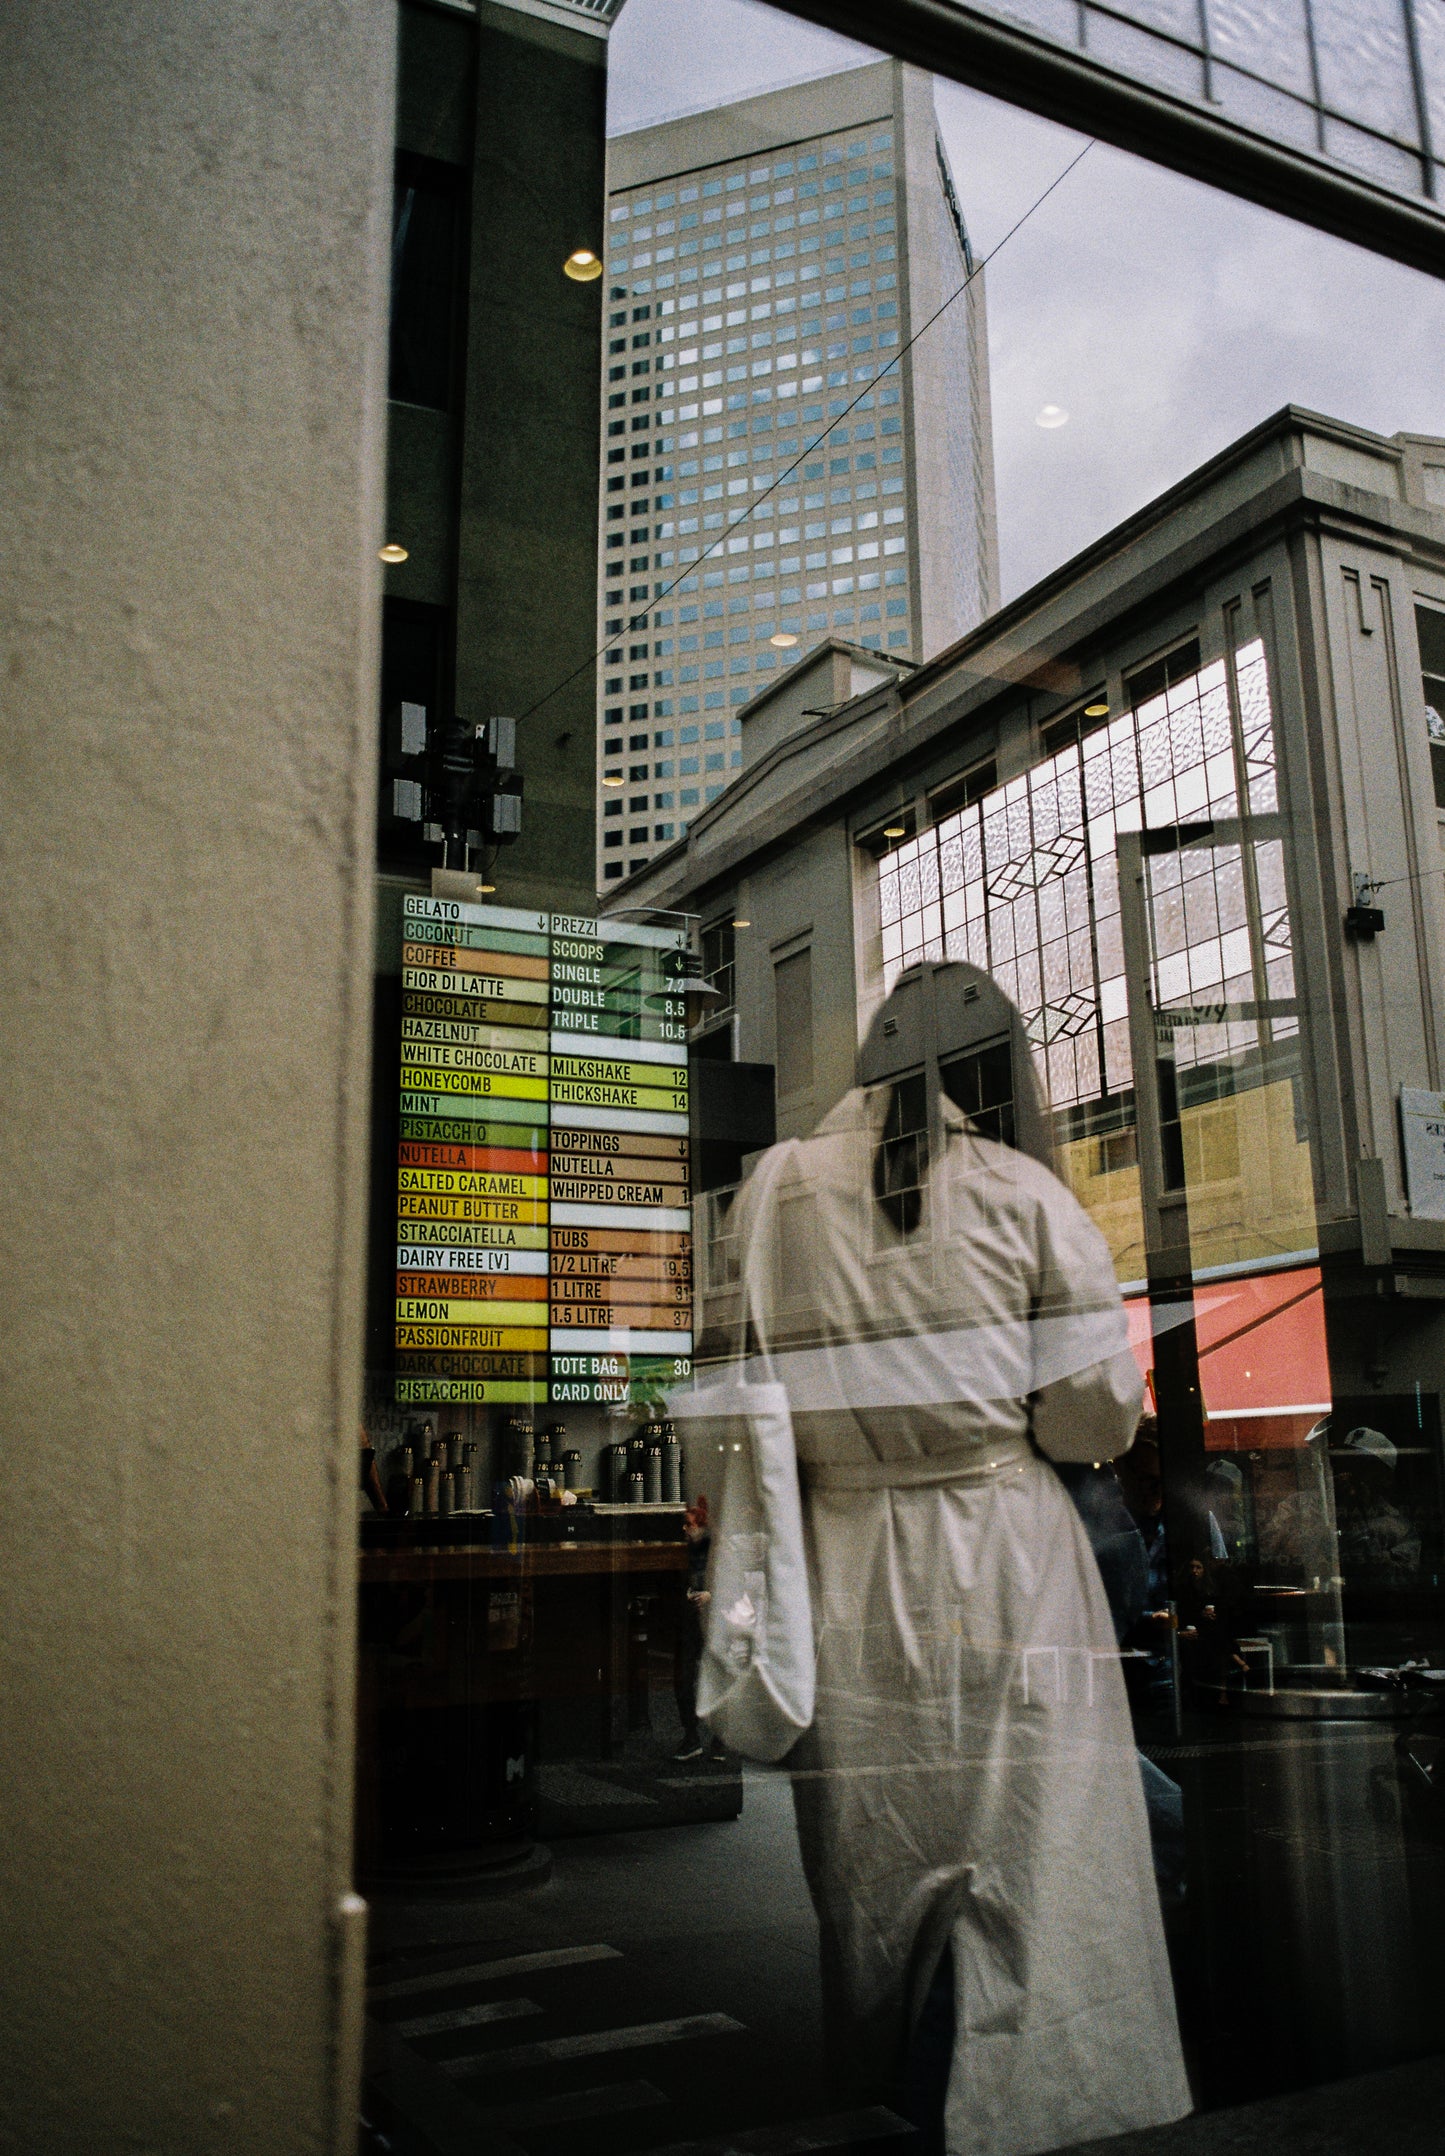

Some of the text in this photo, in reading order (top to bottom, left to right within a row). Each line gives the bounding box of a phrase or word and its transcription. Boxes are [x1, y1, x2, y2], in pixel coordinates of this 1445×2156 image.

[407, 899, 459, 919] GELATO
[406, 923, 472, 944] COCONUT
[553, 917, 598, 935] PREZZI
[406, 947, 457, 967] COFFEE
[553, 942, 604, 960] SCOOPS
[406, 971, 504, 996] FIOR DI LATTE
[553, 965, 685, 993] SINGLE 7.2
[404, 995, 486, 1018] CHOCOLATE
[553, 987, 685, 1016] DOUBLE 8.5
[403, 1021, 479, 1041] HAZELNUT
[552, 1011, 685, 1039] TRIPLE 10.5
[403, 1045, 536, 1072] WHITE CHOCOLATE
[402, 1069, 491, 1093] HONEYCOMB
[553, 1059, 686, 1085] MILKSHAKE 12
[402, 1094, 440, 1113] MINT
[553, 1084, 686, 1108] THICKSHAKE 14
[401, 1120, 486, 1141] PISTACCHIO
[555, 1132, 619, 1151] TOPPINGS
[401, 1145, 466, 1166] NUTELLA
[552, 1157, 687, 1180] NUTELLA 1
[401, 1172, 526, 1194] SALTED CARAMEL
[553, 1182, 688, 1203] WHIPPED CREAM 1
[400, 1197, 519, 1219] PEANUT BUTTER
[400, 1223, 516, 1245] STRACCIATELLA
[553, 1231, 588, 1247] TUBS
[400, 1250, 509, 1270] DAIRY FREE [V]
[553, 1256, 574, 1273] 1/2
[580, 1257, 617, 1274] LITRE
[399, 1276, 496, 1296] STRAWBERRY
[553, 1282, 558, 1297] 1
[564, 1282, 601, 1298] LITRE
[399, 1301, 449, 1319] LEMON
[552, 1308, 689, 1325] 1.5 LITRE 37
[399, 1327, 503, 1347] PASSIONFRUIT
[399, 1355, 524, 1375] DARK CHOCOLATE
[552, 1357, 690, 1375] TOTE BAG 30
[399, 1383, 484, 1400] PISTACCHIO
[552, 1384, 630, 1401] CARD ONLY
